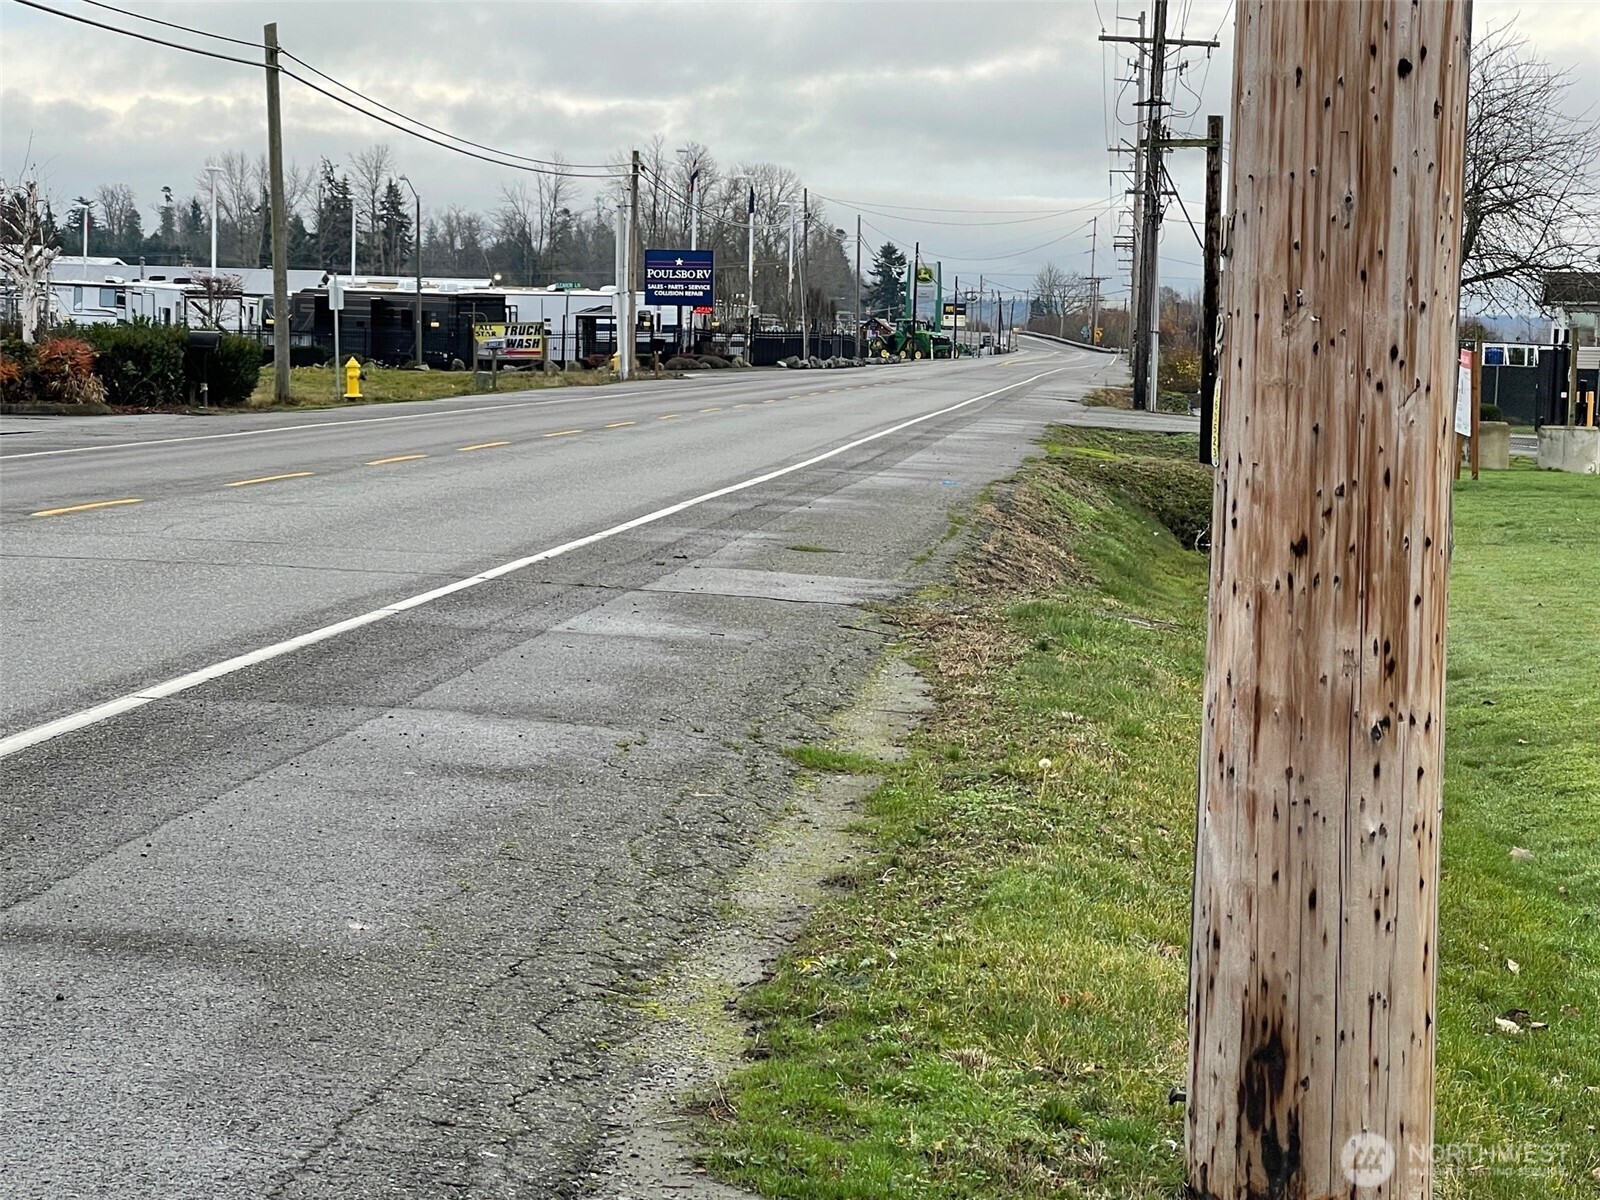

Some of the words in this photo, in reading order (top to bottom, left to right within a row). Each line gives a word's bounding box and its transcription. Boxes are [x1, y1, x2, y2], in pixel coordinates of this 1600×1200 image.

[647, 269, 696, 279] POULSBO
[696, 270, 711, 279] RV
[504, 325, 542, 336] TRUCK
[506, 338, 540, 349] WASH
